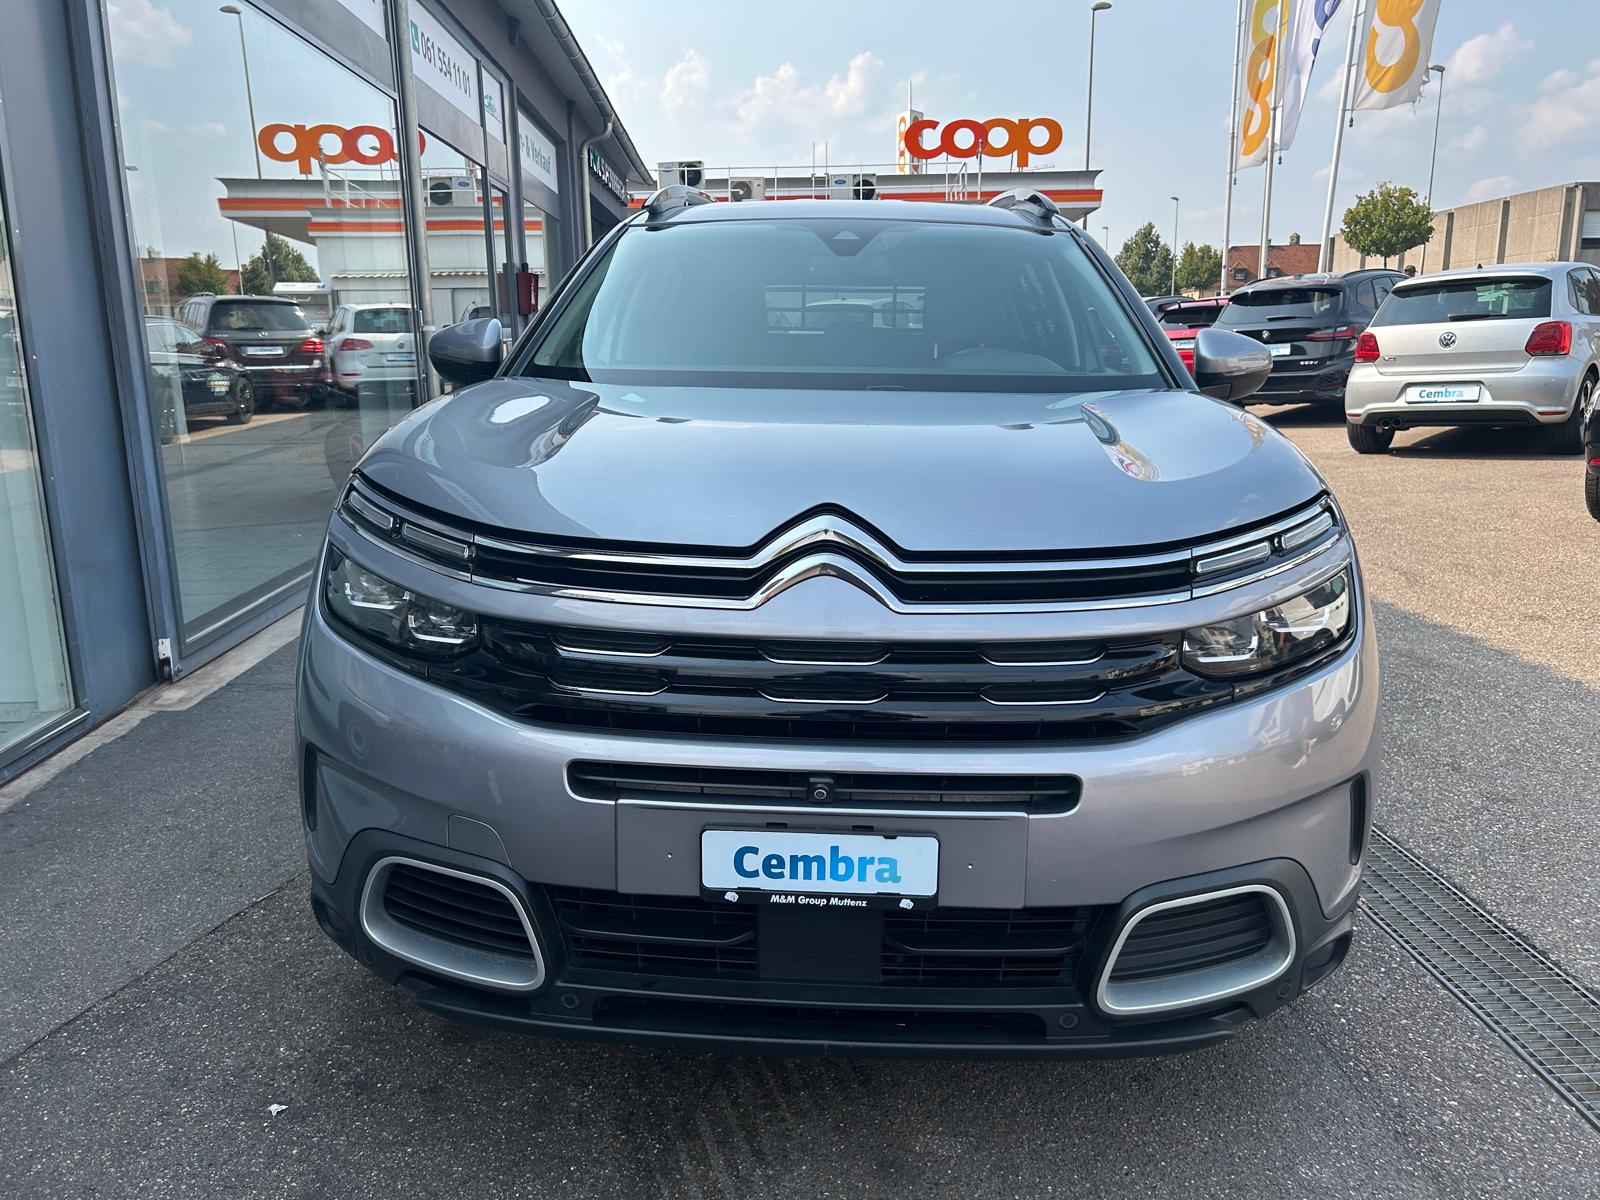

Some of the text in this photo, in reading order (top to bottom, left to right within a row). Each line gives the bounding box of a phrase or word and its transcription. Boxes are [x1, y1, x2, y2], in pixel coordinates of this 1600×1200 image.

[421, 32, 472, 98] 061 554 11 01
[905, 118, 1062, 168] coop
[1419, 388, 1463, 398] Cembra
[734, 845, 902, 883] Cembra
[770, 894, 867, 907] M&M Group Muttenz
